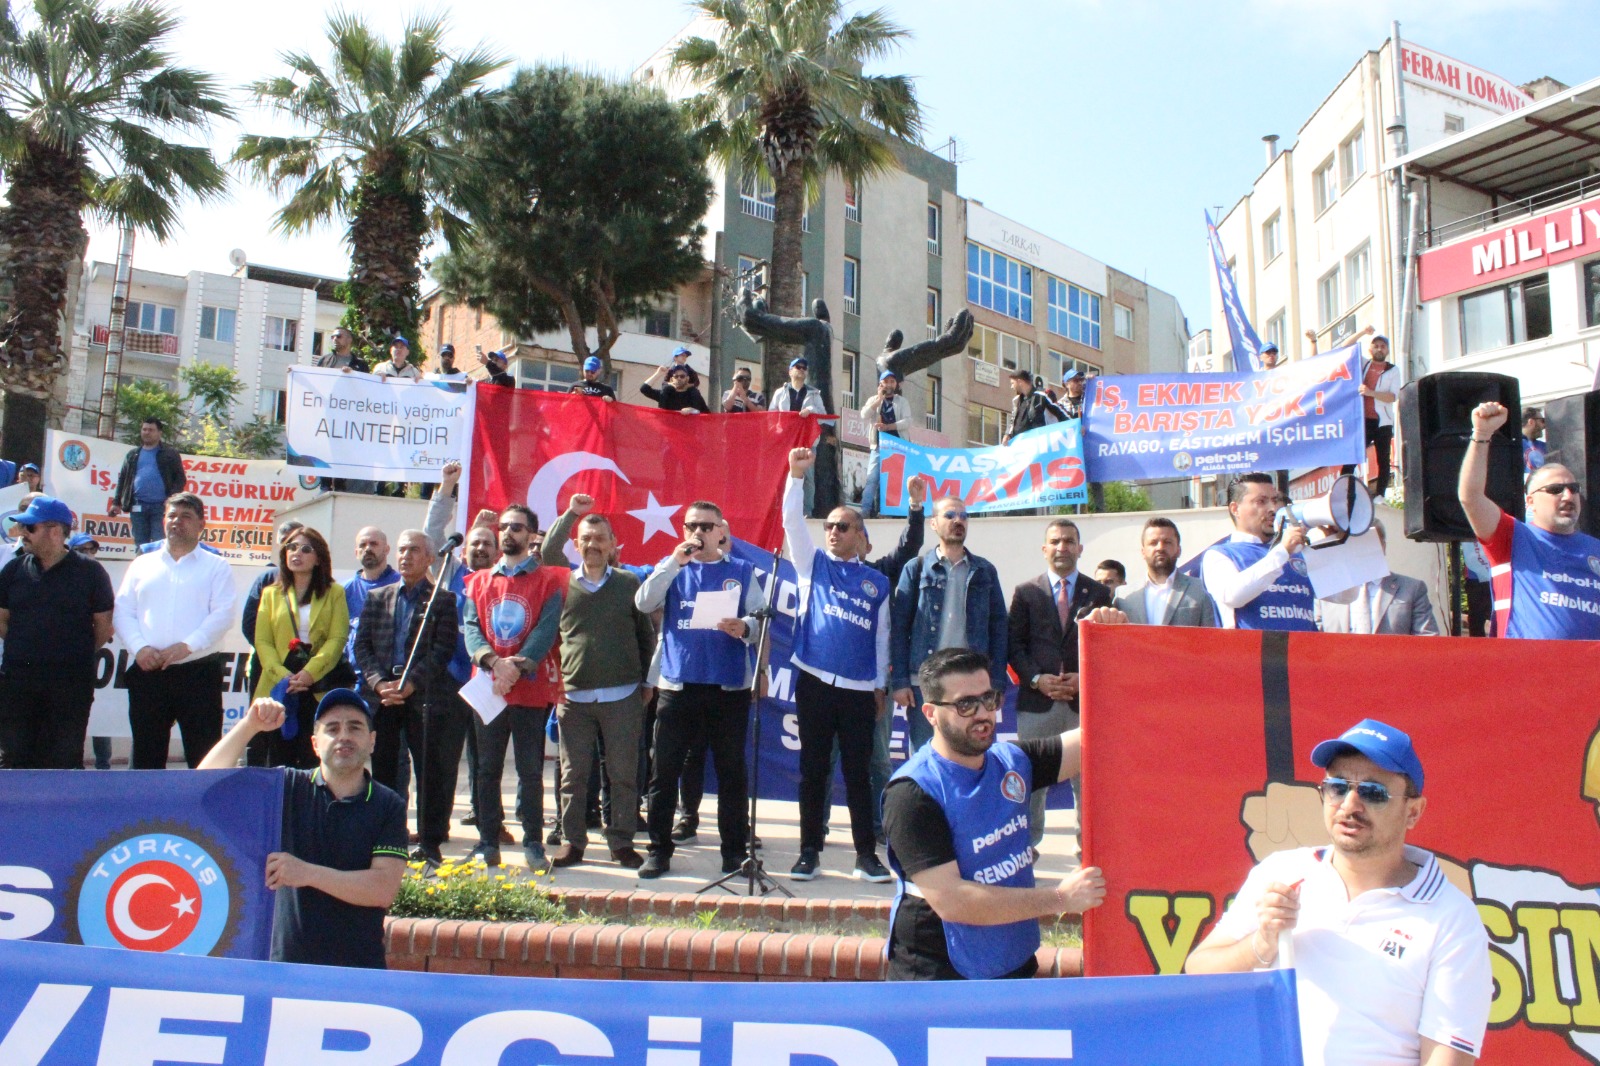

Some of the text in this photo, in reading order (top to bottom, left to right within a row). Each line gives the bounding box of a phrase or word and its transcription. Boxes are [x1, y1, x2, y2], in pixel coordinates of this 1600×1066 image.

[1402, 48, 1461, 90] FERAH
[1002, 229, 1041, 256] TARKAN
[1095, 362, 1351, 414] İŞ, EKMEK YOA
[303, 392, 462, 421] En bereketli yağmur
[315, 418, 448, 445] ALINTERİDİR
[1114, 409, 1234, 437] BARIŞTA
[926, 428, 1076, 477] YAŞSIN
[1098, 420, 1343, 458] RAVAGO, EASTCHEM İŞÇİLERİ
[183, 459, 248, 476] ŞASIN
[1195, 451, 1259, 466] petrol-iş
[184, 475, 297, 501] ÖZGÜRLÜK
[881, 453, 1085, 507] 1 MAYIS
[85, 519, 133, 538] RAVA
[230, 526, 273, 549] İŞÇİLE
[1260, 604, 1314, 622] SENDİKAS
[92, 838, 219, 886] TÜRK-İŞ
[973, 845, 1033, 884] SENDİKAS
